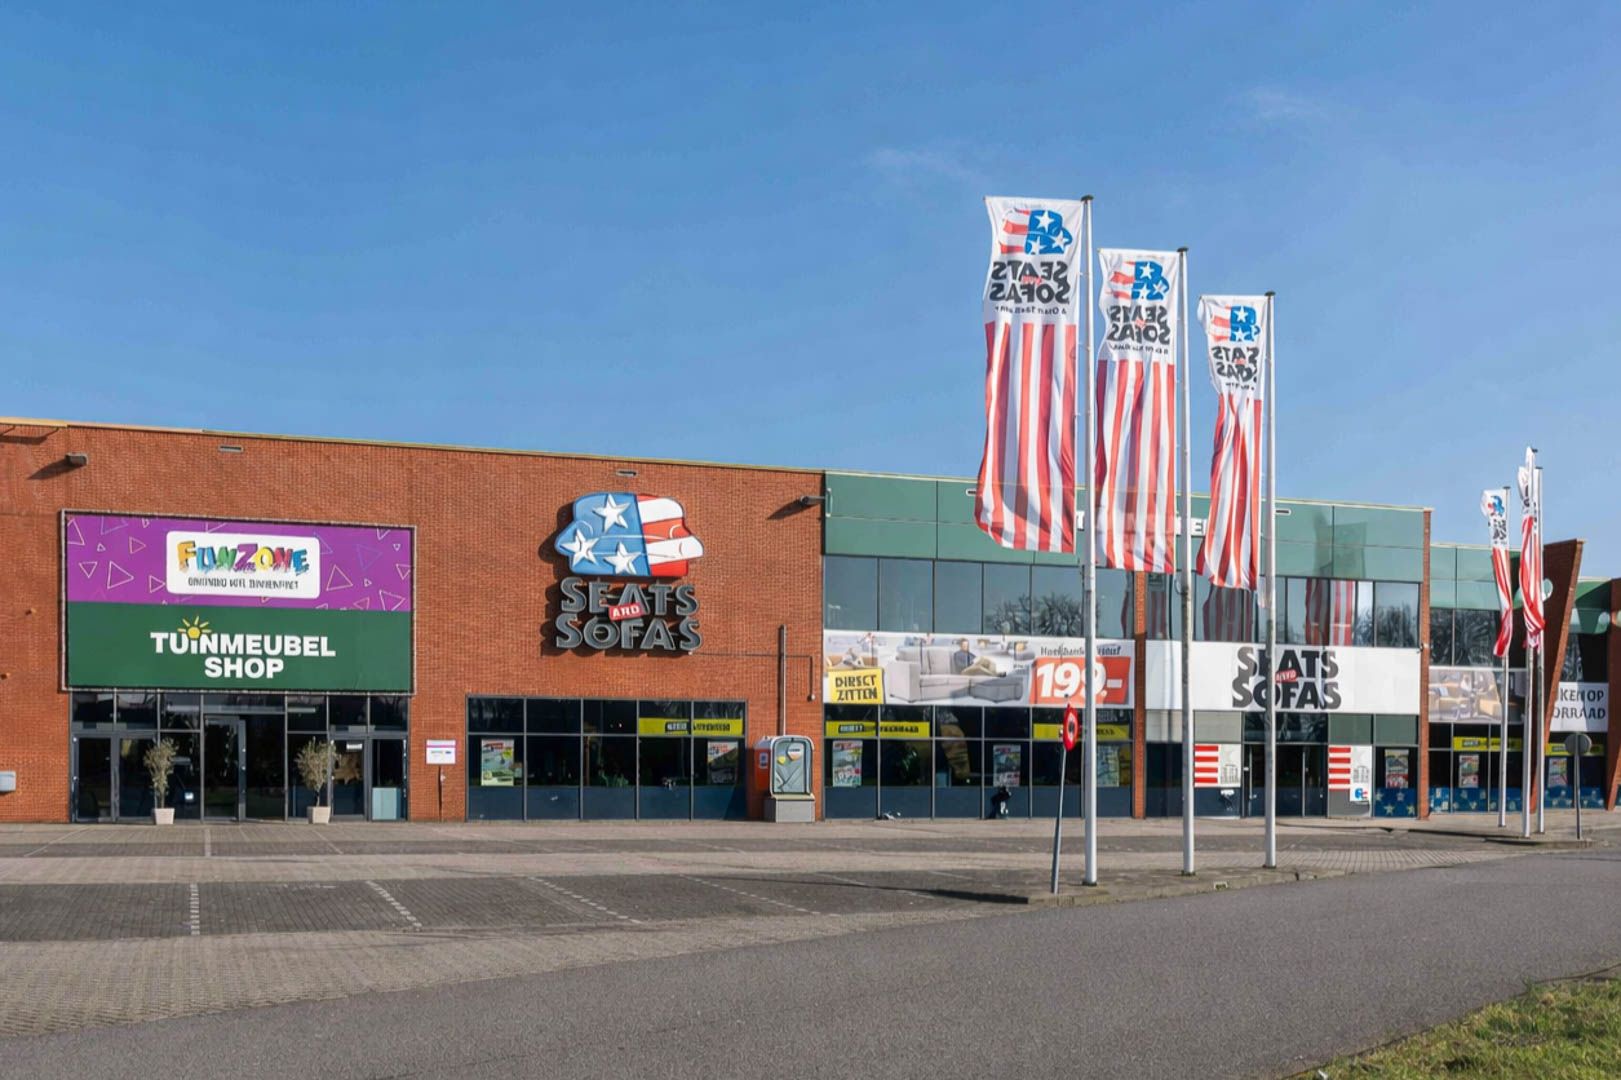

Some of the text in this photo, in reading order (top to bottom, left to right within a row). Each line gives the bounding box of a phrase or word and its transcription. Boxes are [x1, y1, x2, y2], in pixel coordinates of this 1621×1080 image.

[560, 577, 699, 615] SEATS
[555, 613, 702, 649] SOFAS
[204, 656, 284, 679] SHOP
[1232, 680, 1342, 709] SOFAS
[1560, 688, 1604, 702] KEN OP
[1553, 707, 1606, 719] ORRAAD
